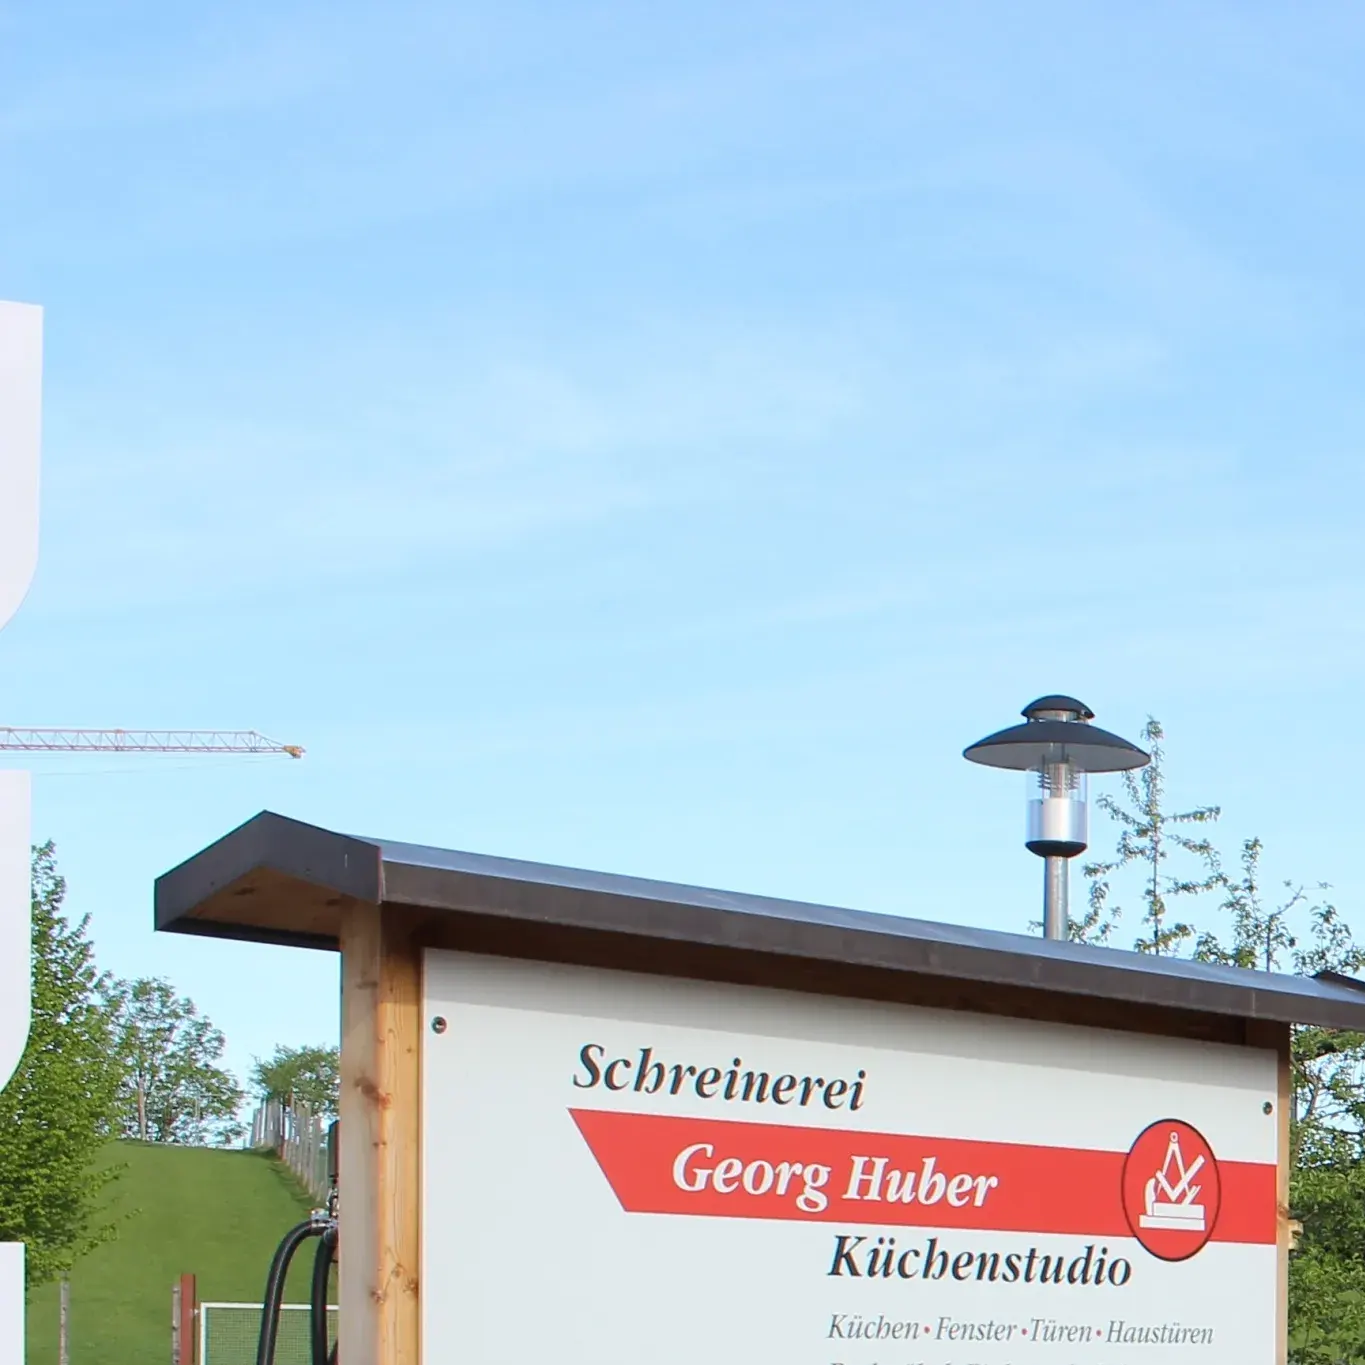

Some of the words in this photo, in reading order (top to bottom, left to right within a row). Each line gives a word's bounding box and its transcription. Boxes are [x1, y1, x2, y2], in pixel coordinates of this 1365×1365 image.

[573, 1043, 867, 1112] Schreinerei
[672, 1143, 832, 1212] Georg
[842, 1154, 998, 1208] Huber
[827, 1234, 1132, 1287] Küchenstudio
[826, 1313, 920, 1341] Küchen
[934, 1316, 1018, 1342] Fenster
[1030, 1317, 1093, 1343] Türen
[1105, 1319, 1214, 1345] Haustüren
